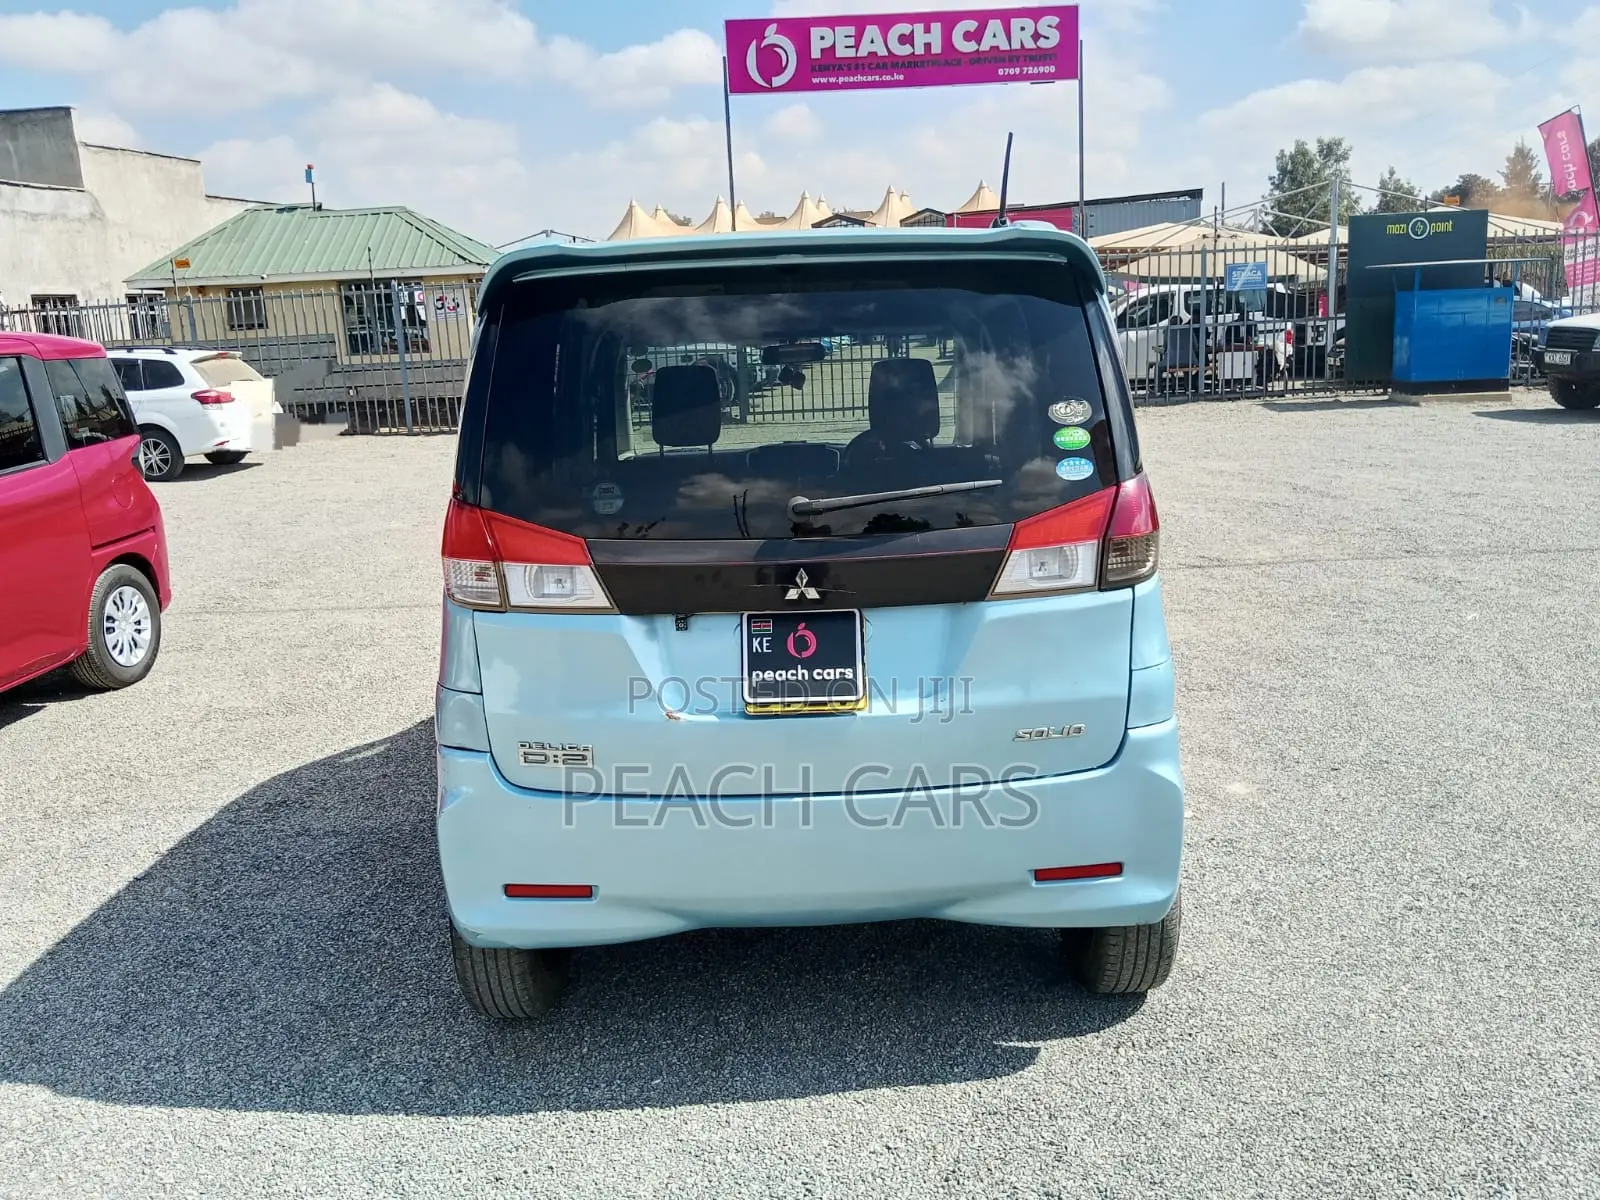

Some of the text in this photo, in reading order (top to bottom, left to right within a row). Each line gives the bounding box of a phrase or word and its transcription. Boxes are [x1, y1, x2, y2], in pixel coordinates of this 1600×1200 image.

[809, 16, 1060, 59] PEACH CARS
[811, 63, 852, 73] KENYA'S
[868, 61, 888, 70] CAR
[890, 57, 963, 69] MARKETPLACE
[1007, 55, 1021, 63] BY
[998, 65, 1056, 76] 0709 726900
[811, 72, 905, 84] www.peachcars.co.ke
[1386, 219, 1453, 236] mazi point
[752, 637, 772, 653] KE
[752, 665, 854, 688] peach cars
[1013, 723, 1086, 742] SOLIO
[518, 741, 593, 752] DELICA
